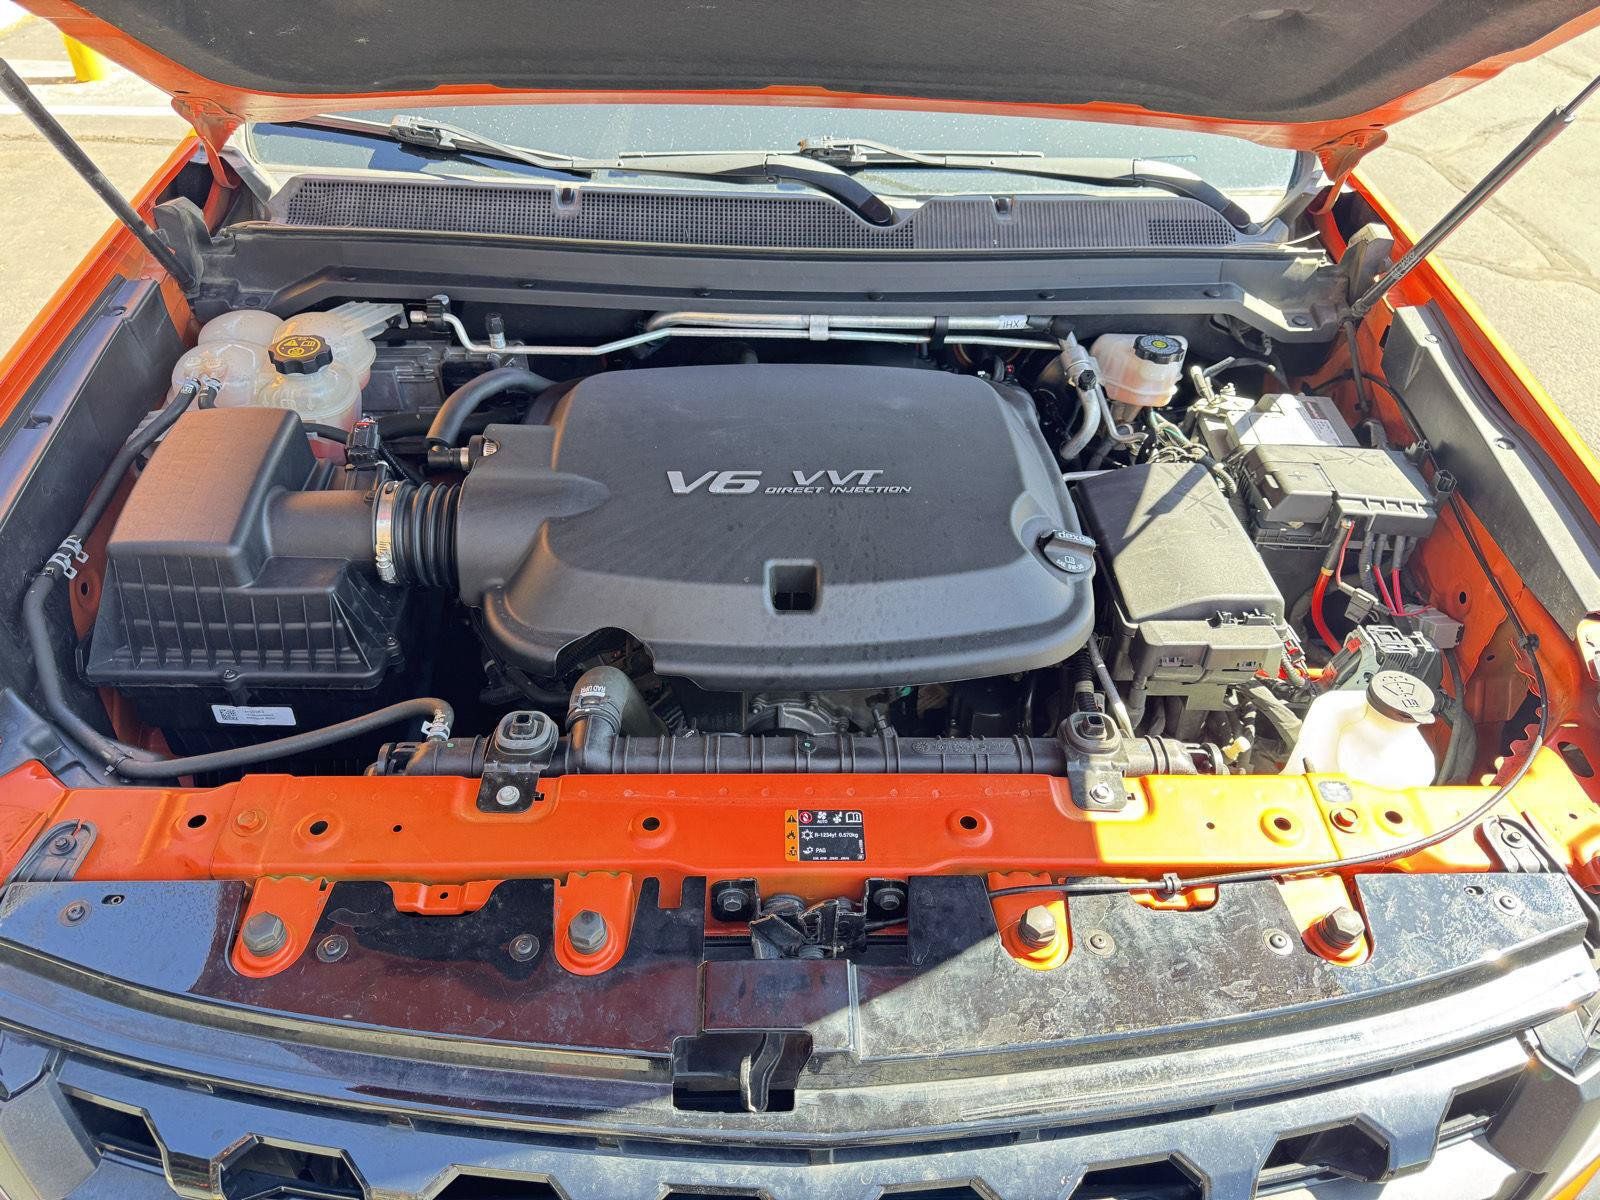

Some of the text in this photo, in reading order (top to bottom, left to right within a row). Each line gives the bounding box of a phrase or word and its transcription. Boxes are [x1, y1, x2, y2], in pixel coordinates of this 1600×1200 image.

[666, 470, 763, 494] V6
[792, 469, 884, 486] VVT
[764, 486, 912, 494] DIRECT INJECTION
